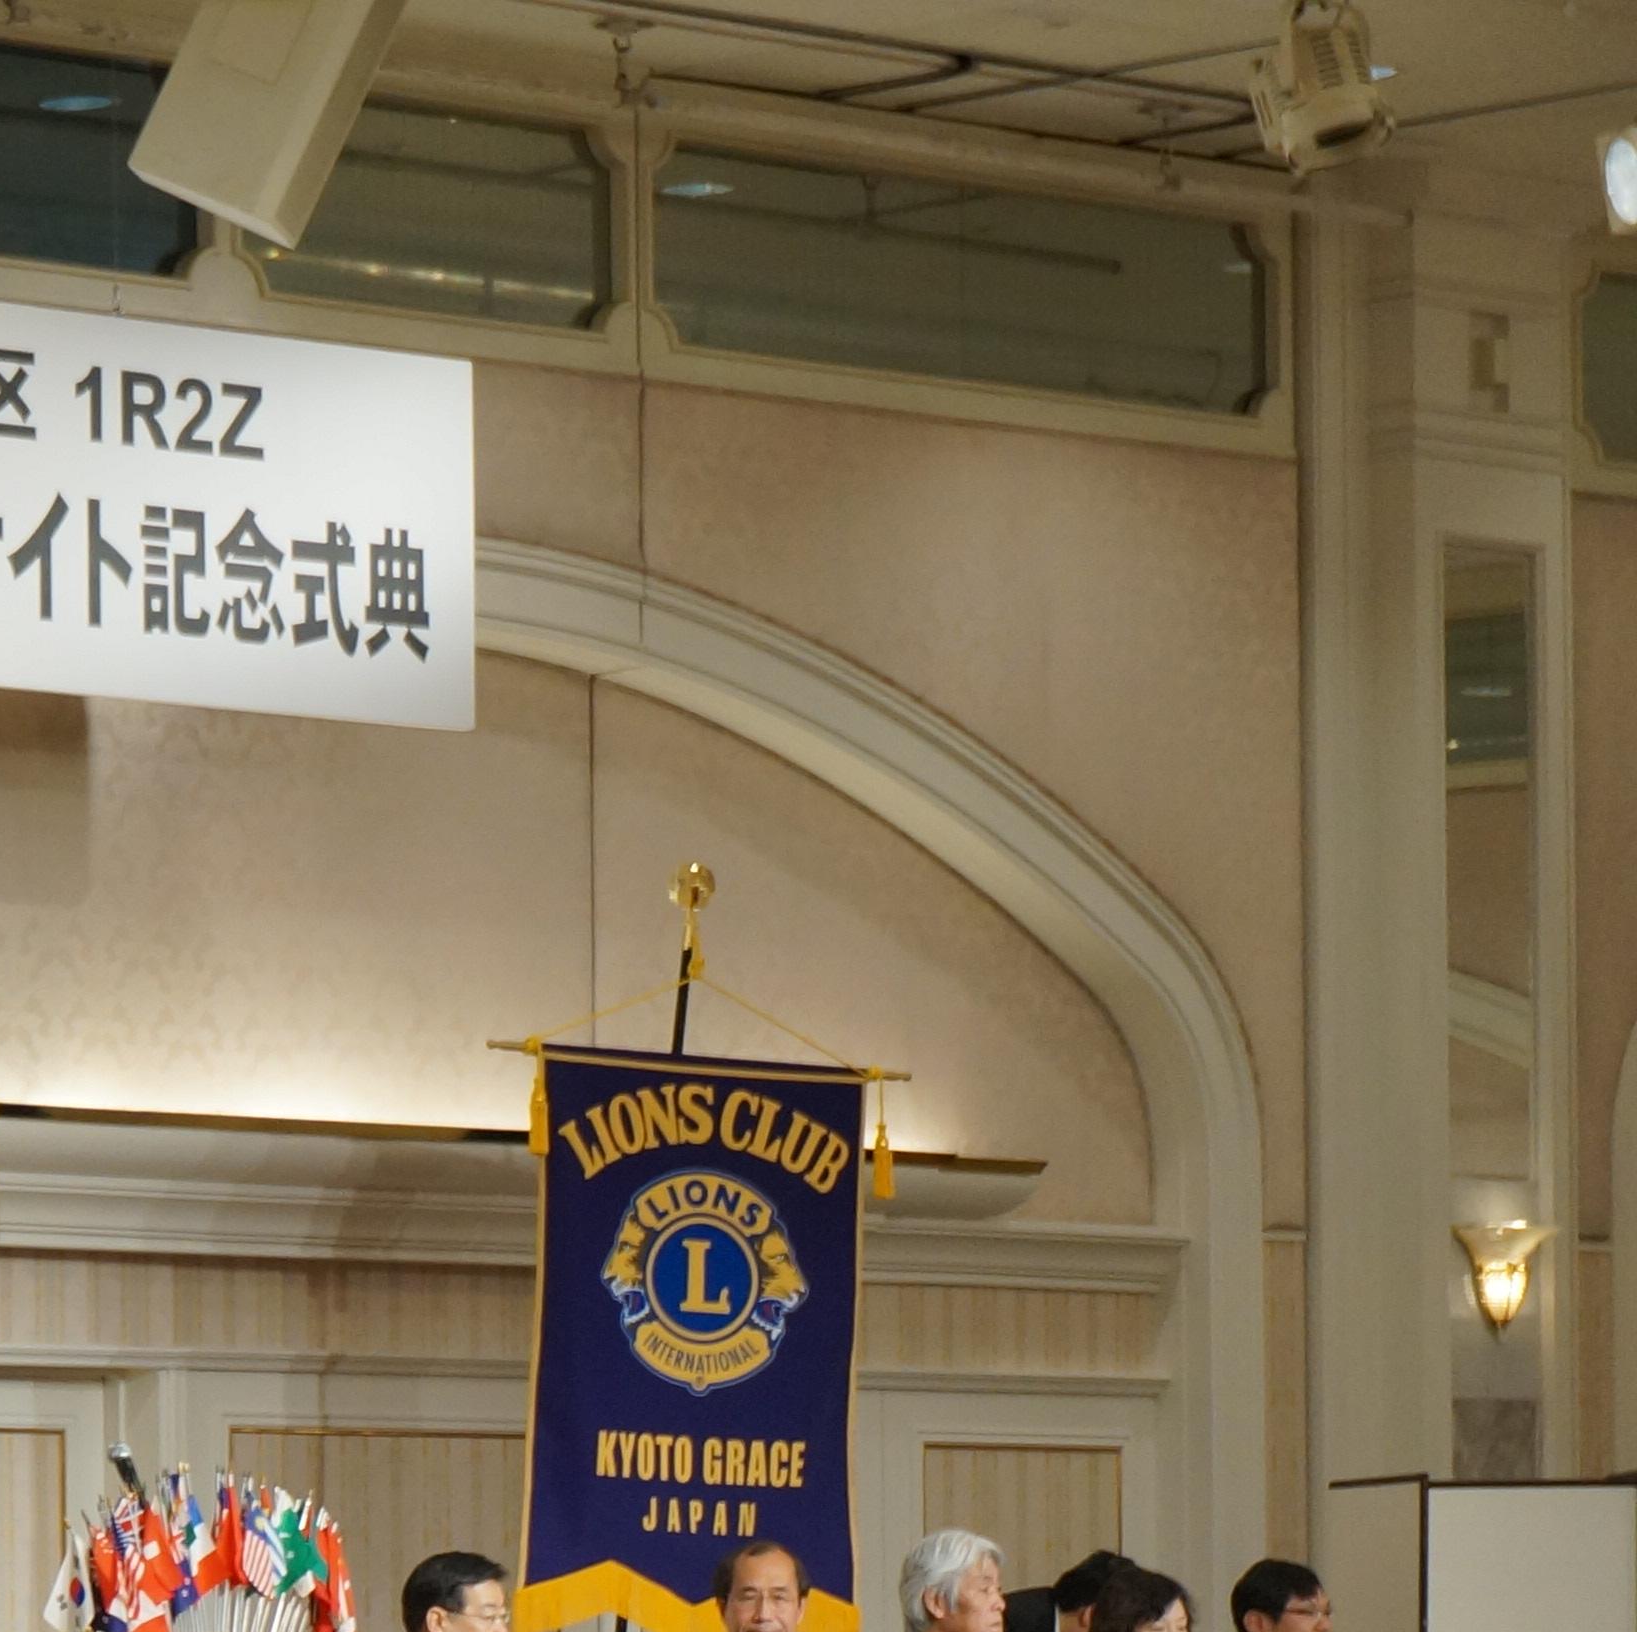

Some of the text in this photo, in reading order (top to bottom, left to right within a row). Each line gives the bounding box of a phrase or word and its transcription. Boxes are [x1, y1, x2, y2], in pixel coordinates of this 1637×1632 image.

[73, 366, 265, 464] 1R2Z
[558, 1082, 851, 1196] LIONS CLUB
[647, 1179, 763, 1227] LIONS
[679, 1237, 731, 1316] L
[643, 1330, 759, 1376] INTERNATIONAL
[595, 1428, 807, 1489] KYOTO GRACE
[642, 1496, 758, 1538] JAPAN
